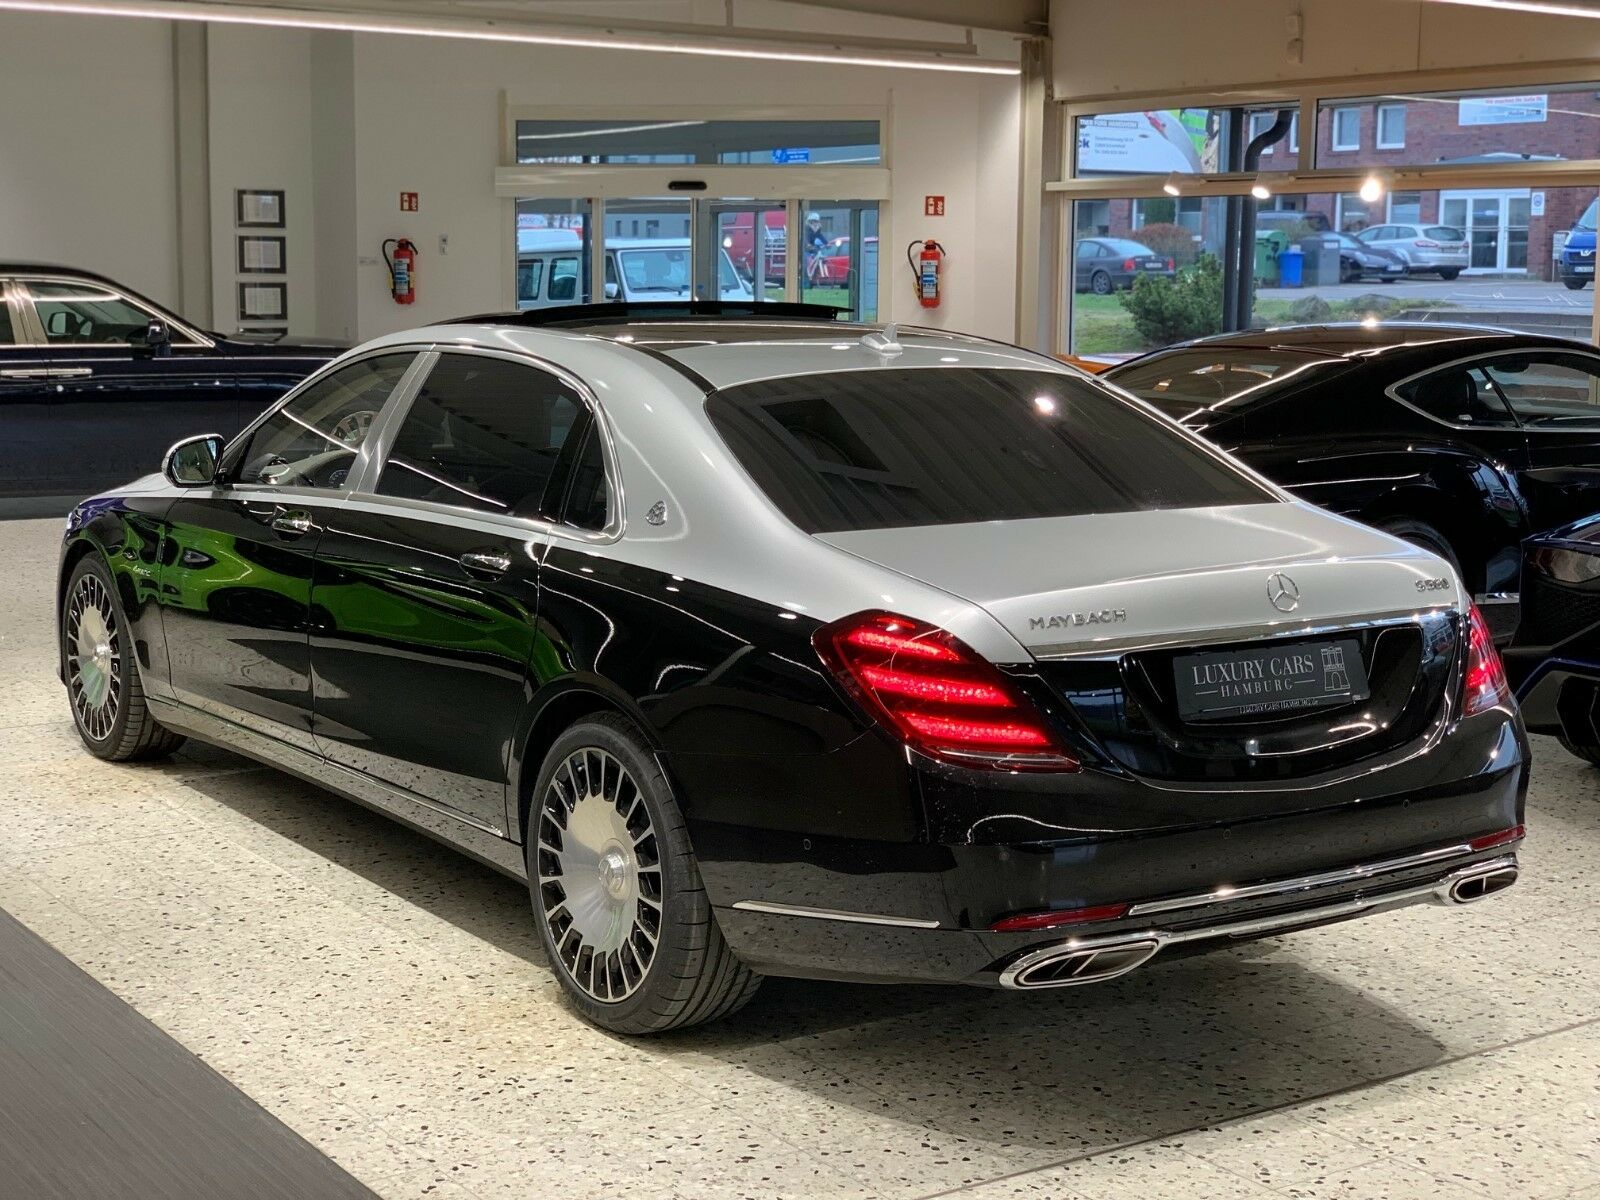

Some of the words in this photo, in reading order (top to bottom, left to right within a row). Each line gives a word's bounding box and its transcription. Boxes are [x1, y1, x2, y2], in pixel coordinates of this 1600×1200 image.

[1028, 607, 1127, 630] MAYBACH
[1192, 658, 1265, 686] LUXURY
[1270, 654, 1314, 677] CARS
[1221, 678, 1293, 698] HAMBURG
